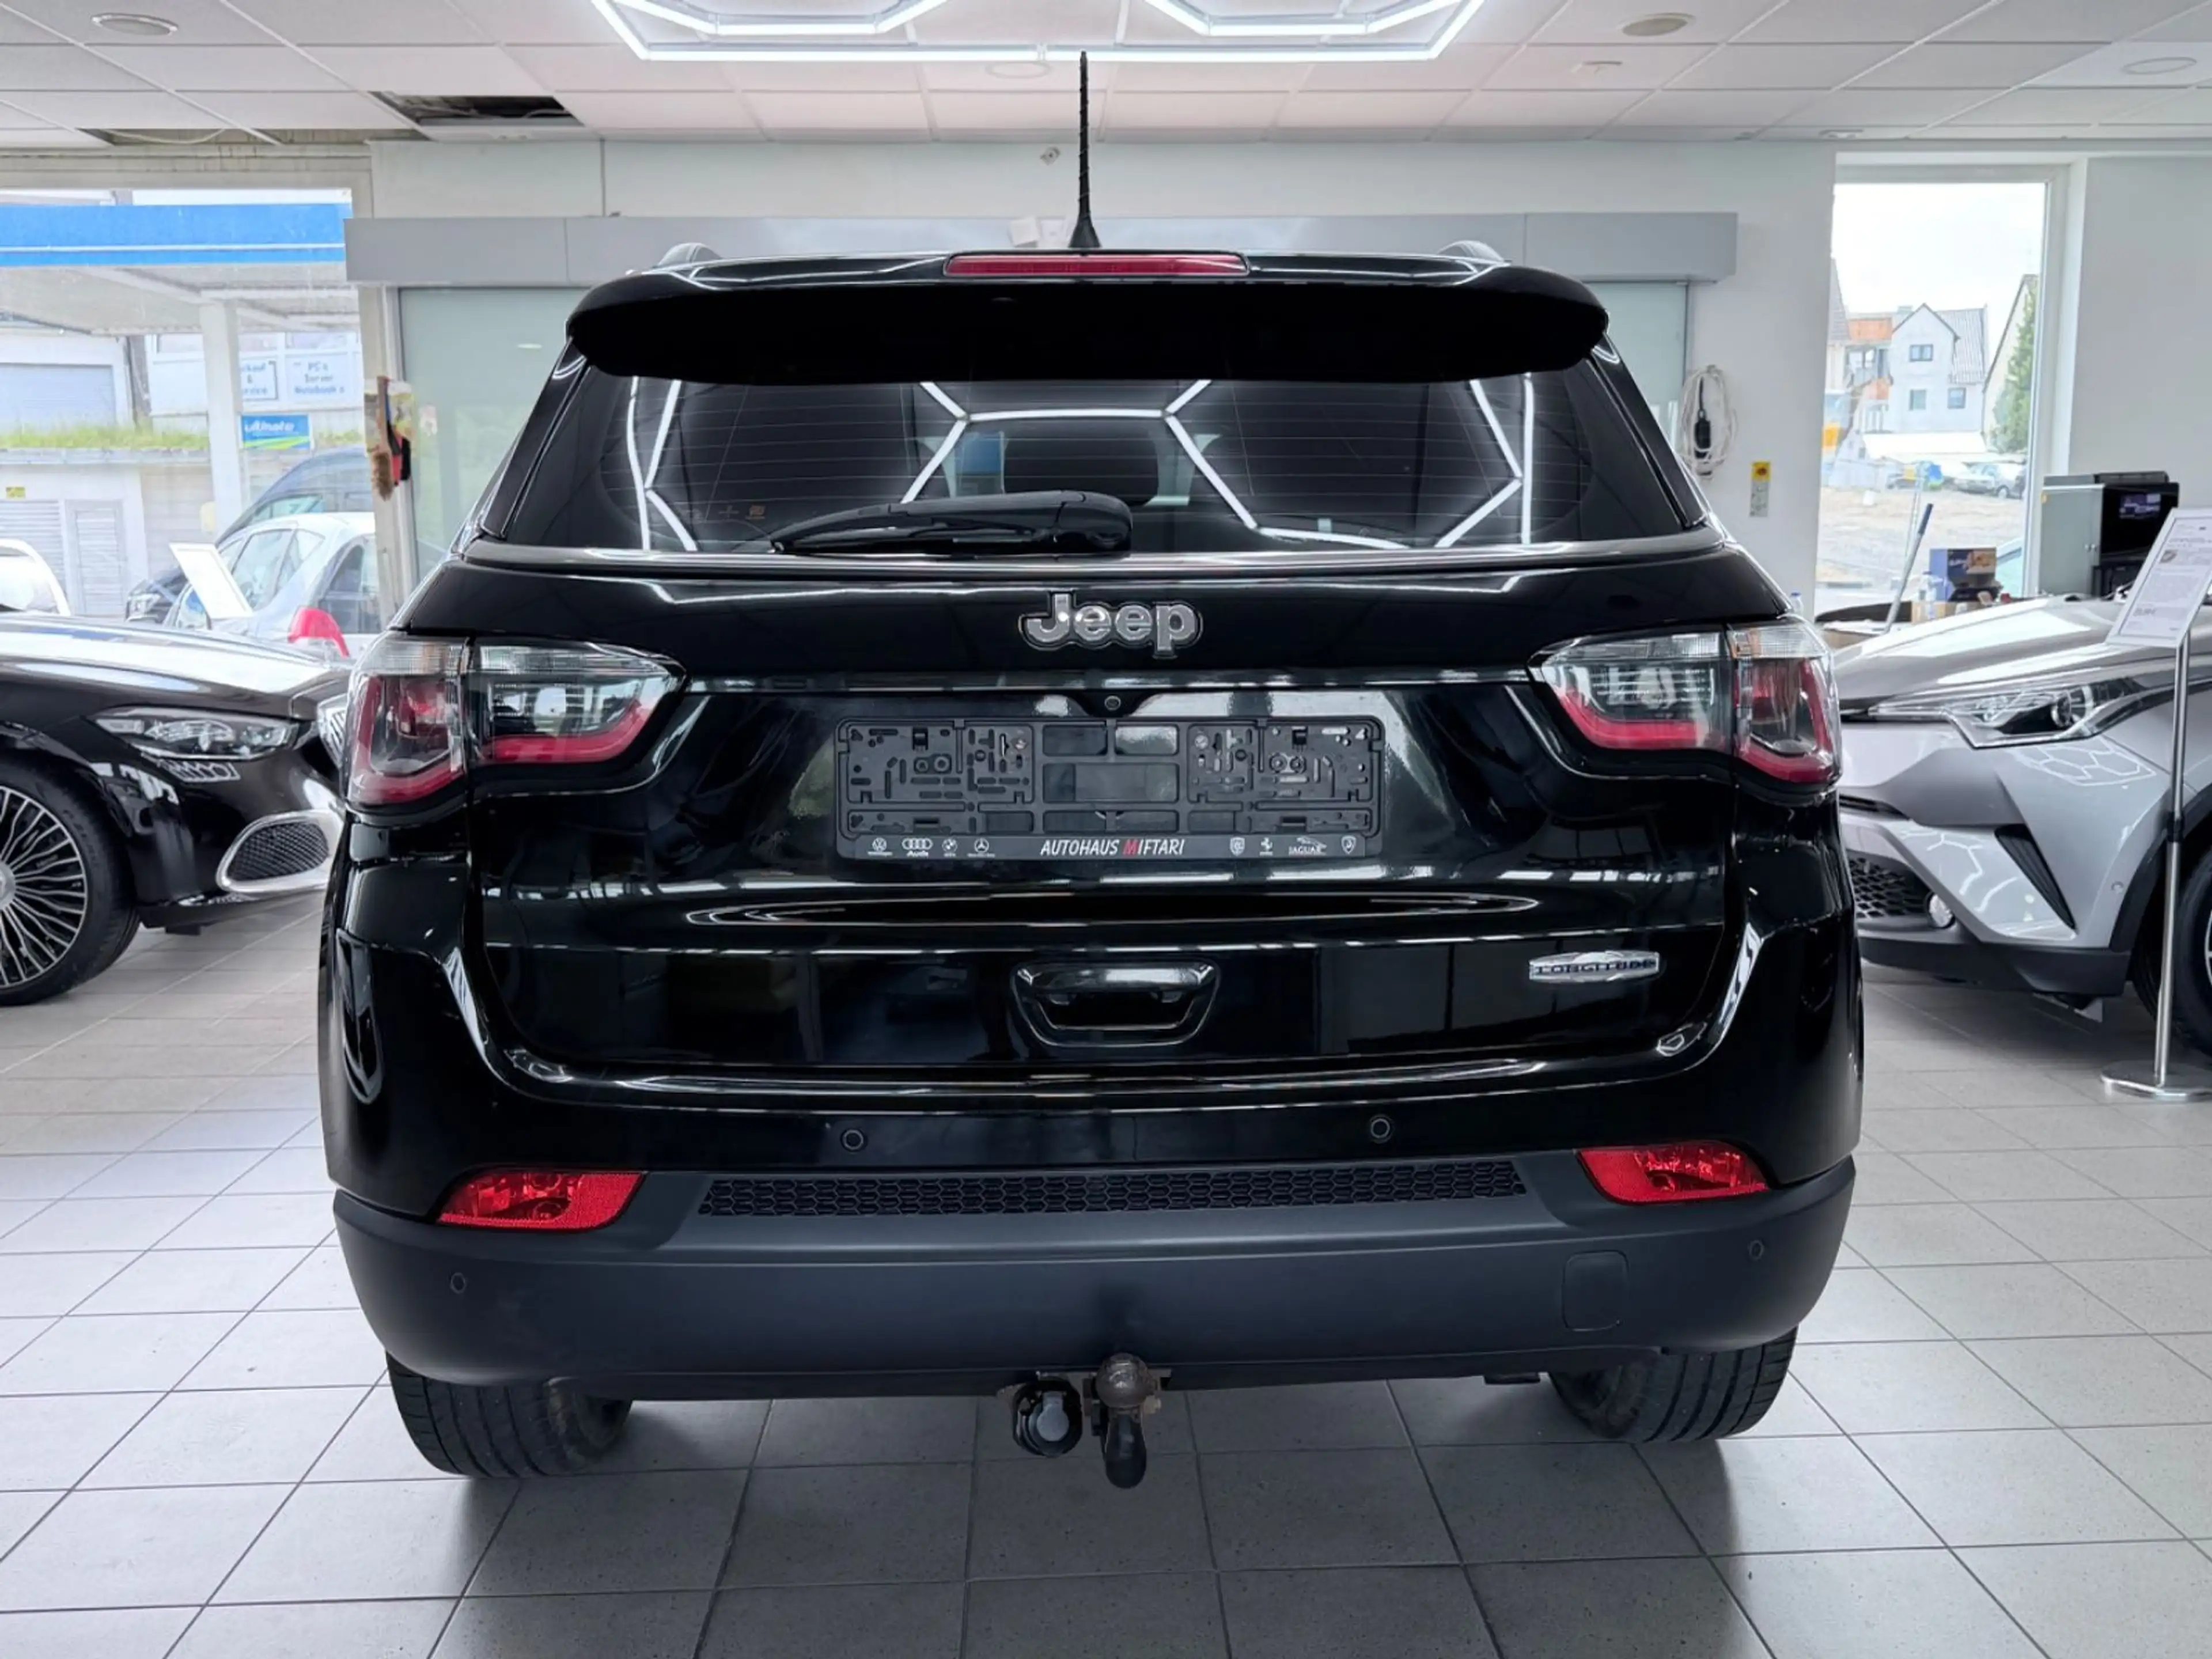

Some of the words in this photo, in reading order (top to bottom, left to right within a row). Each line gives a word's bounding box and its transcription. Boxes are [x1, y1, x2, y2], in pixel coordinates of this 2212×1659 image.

[1023, 592, 1199, 653] Jeep
[906, 850, 929, 858] Audi
[1039, 839, 1120, 857] AUTOHAUS
[1122, 838, 1186, 857] MIFTARI
[1536, 958, 1657, 975] LONGITUDE
